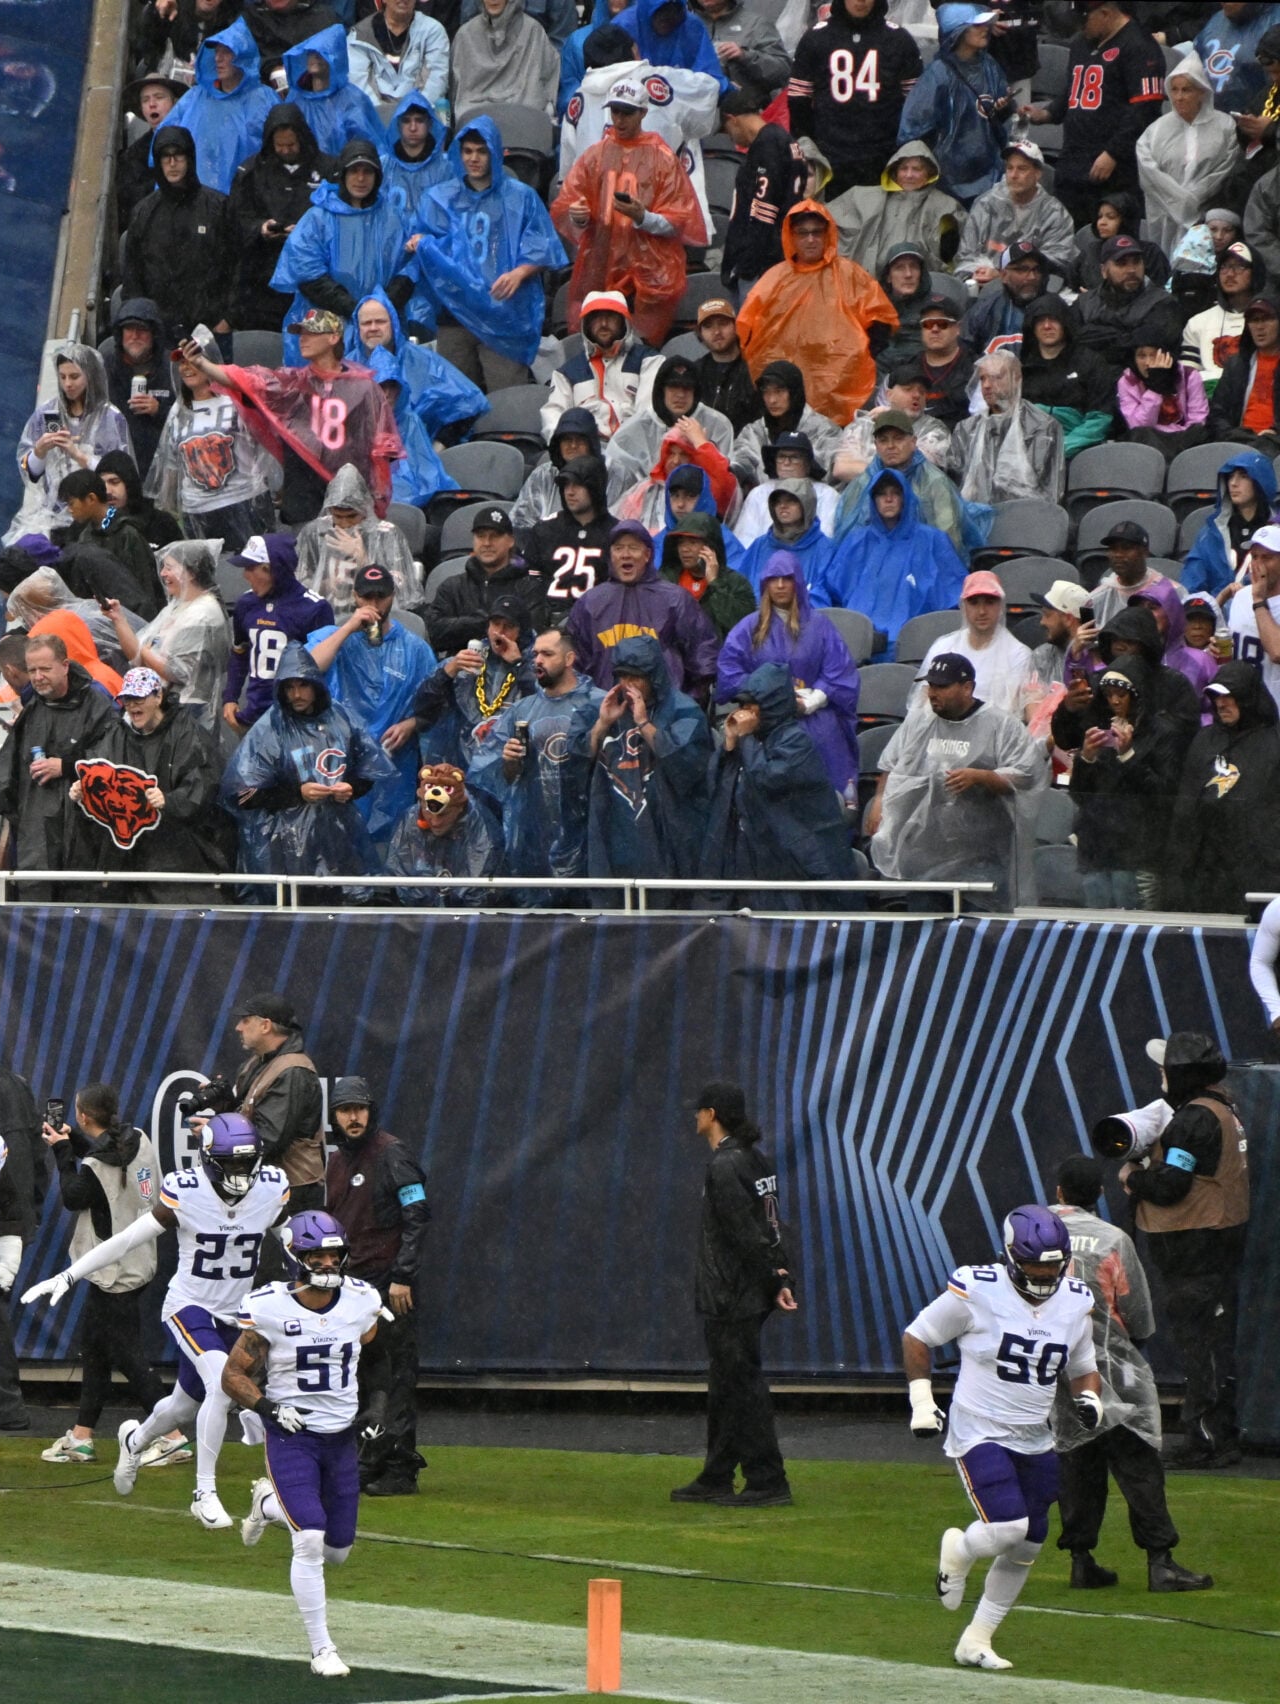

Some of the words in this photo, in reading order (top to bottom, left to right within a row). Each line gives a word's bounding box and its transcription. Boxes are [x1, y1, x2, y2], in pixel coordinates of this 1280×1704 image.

[828, 49, 881, 103] 84
[1068, 65, 1104, 110] 18
[311, 394, 347, 450] 18
[547, 546, 602, 598] 25
[248, 628, 288, 680] 18
[315, 748, 347, 779] C
[191, 1232, 264, 1280] 23
[296, 1342, 353, 1392] 51
[997, 1332, 1068, 1385] 50
